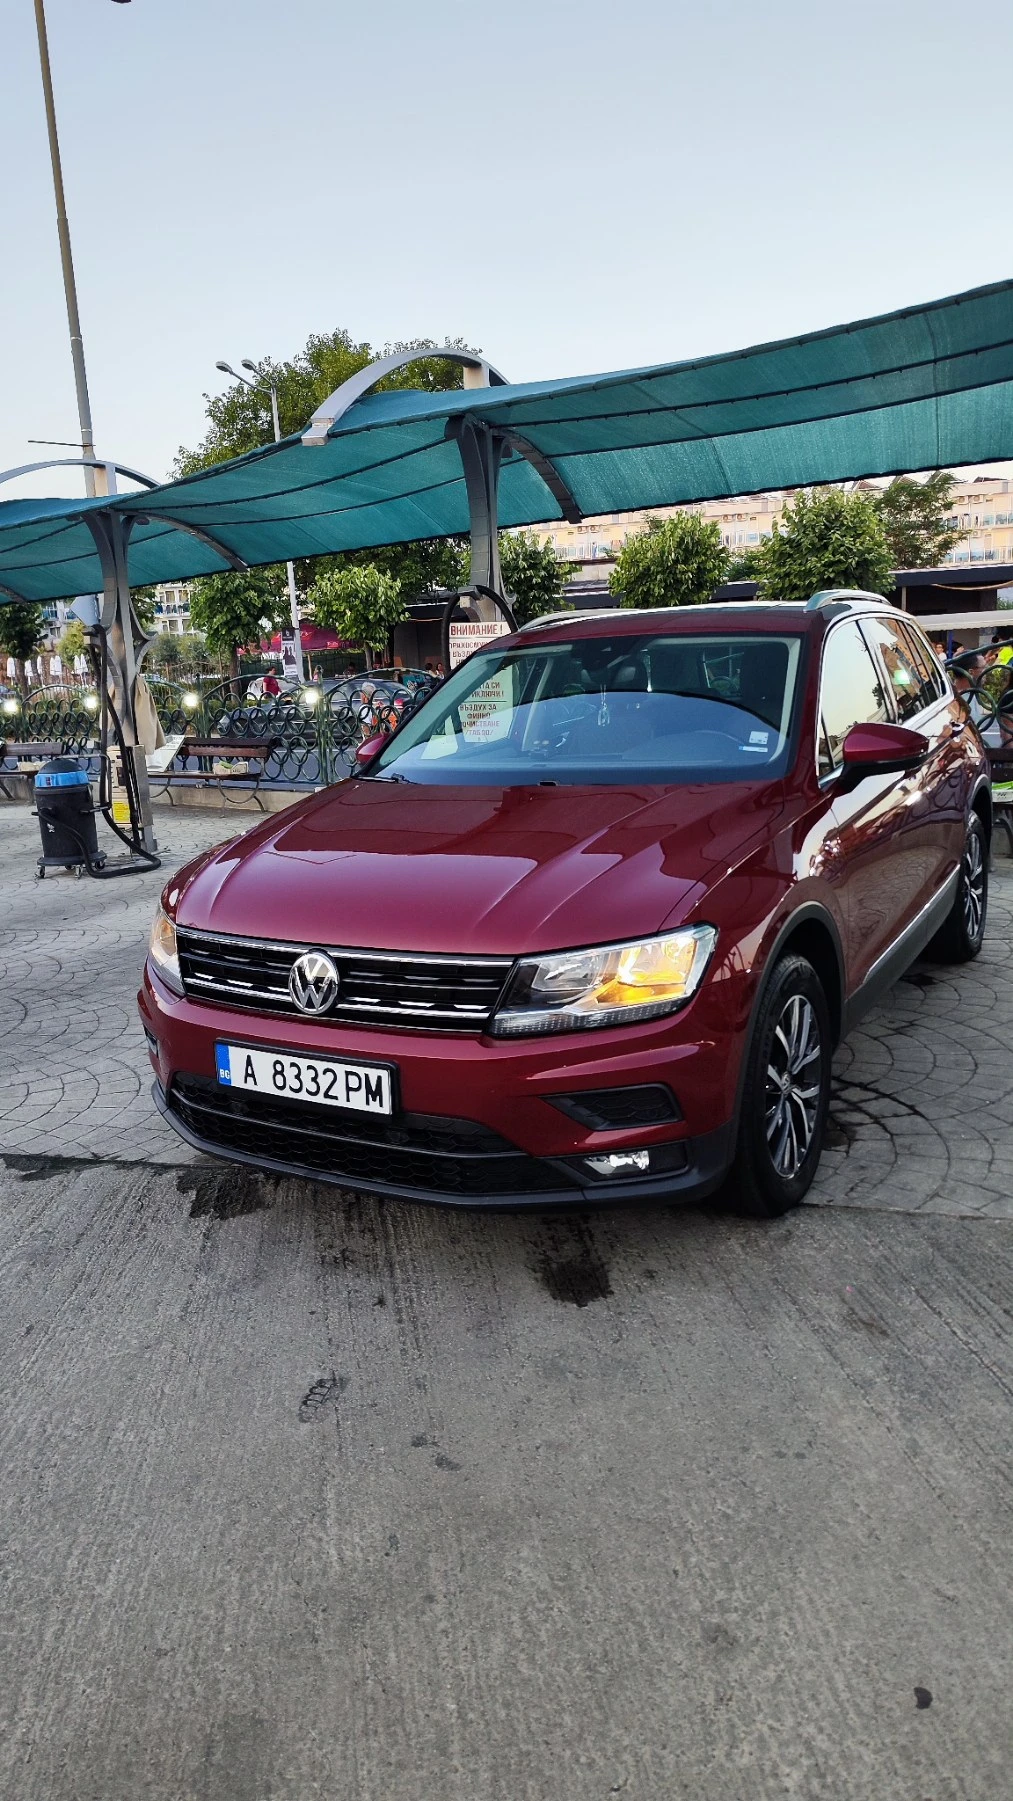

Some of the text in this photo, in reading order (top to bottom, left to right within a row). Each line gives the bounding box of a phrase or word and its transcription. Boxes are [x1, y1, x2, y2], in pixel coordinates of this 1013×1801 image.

[459, 703, 497, 712] ВЪЗДУХ ЗА
[462, 720, 500, 728] ОЧИСТВАНЕ
[244, 1054, 258, 1087] A
